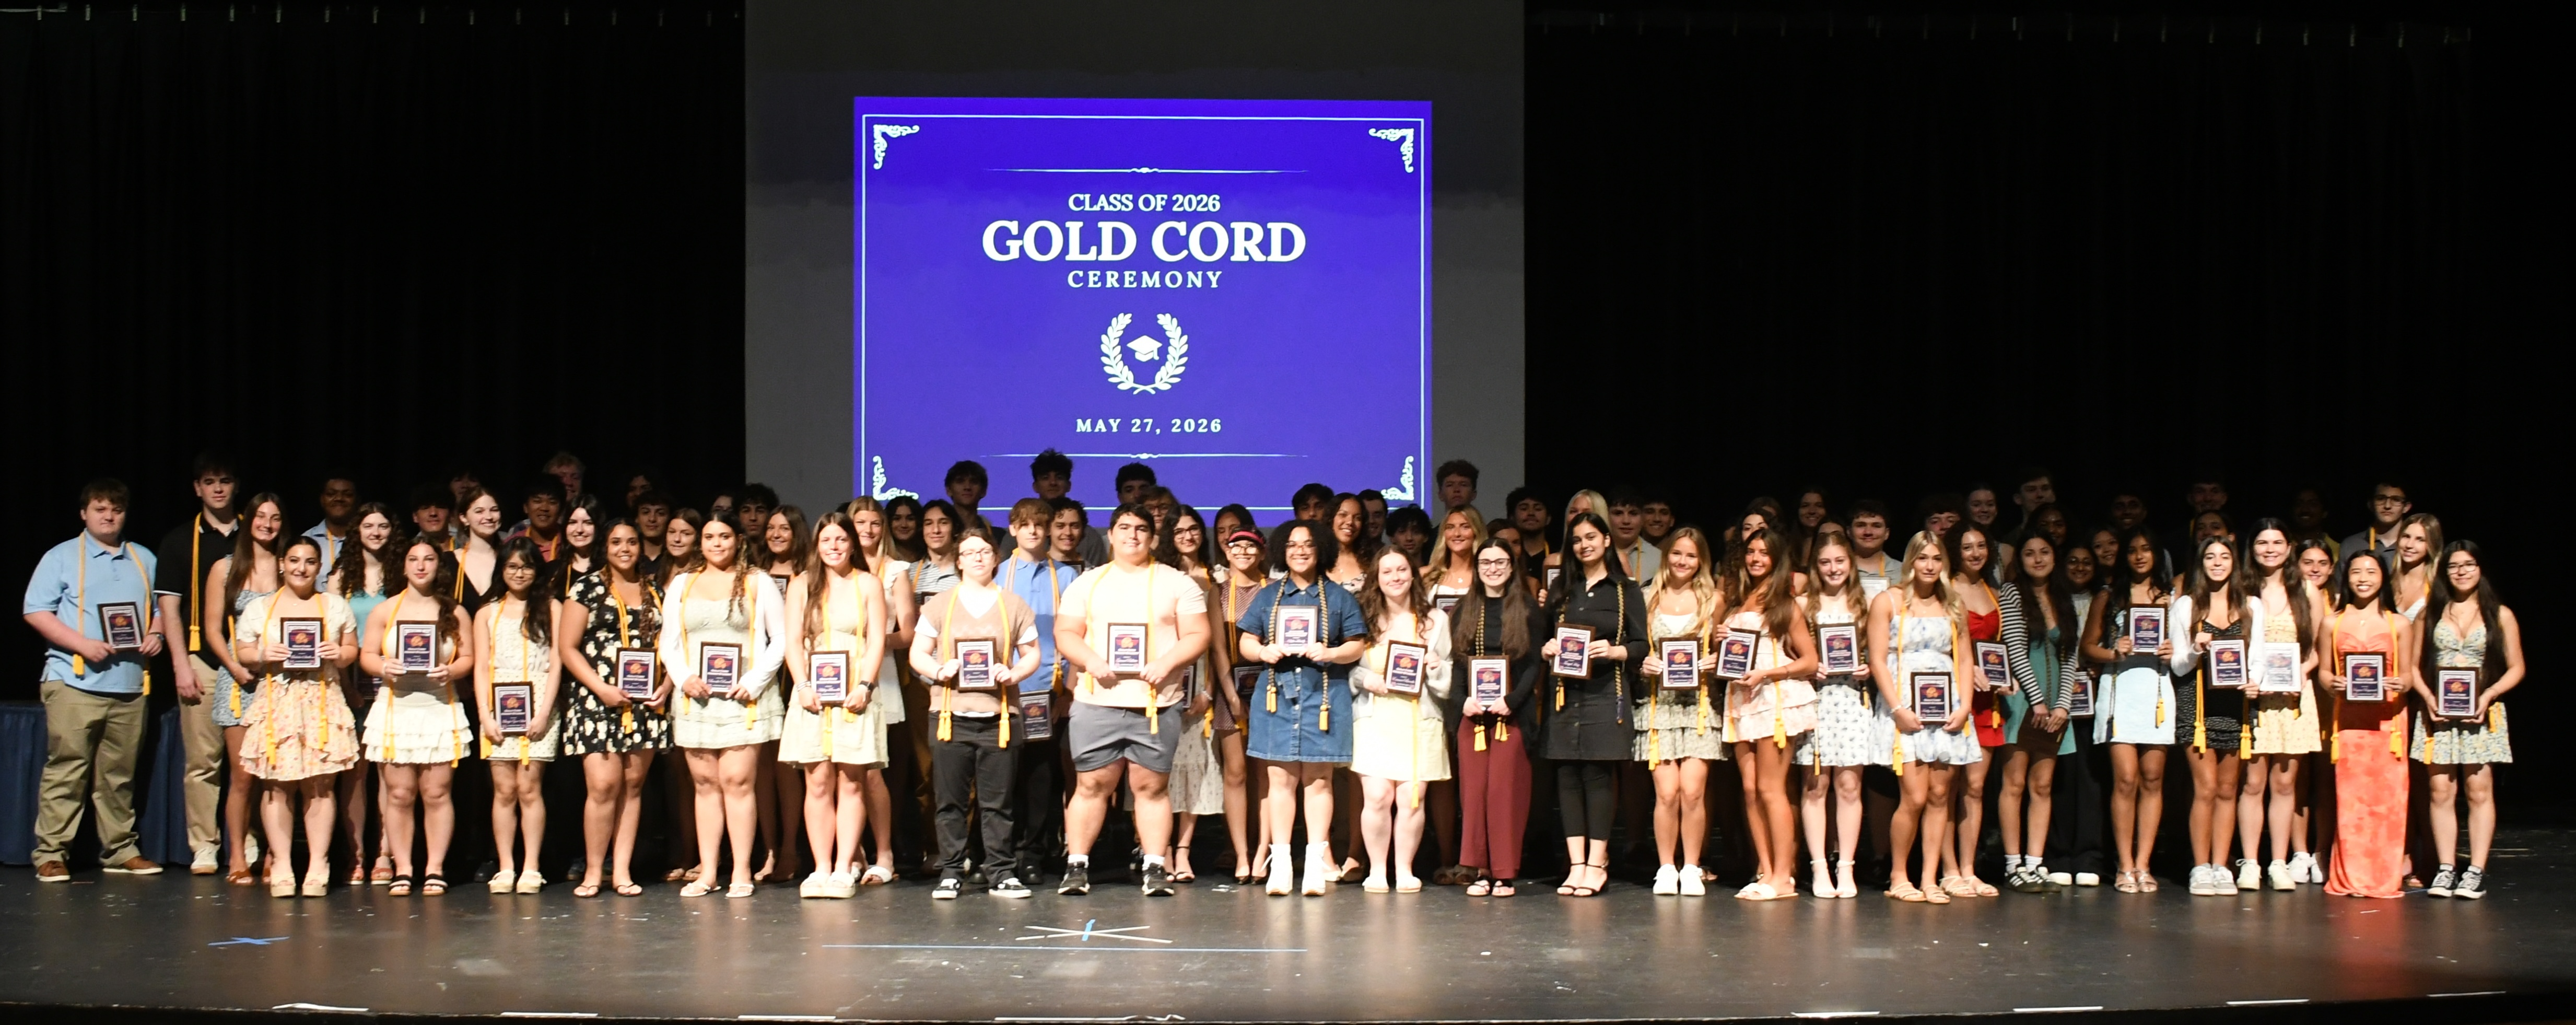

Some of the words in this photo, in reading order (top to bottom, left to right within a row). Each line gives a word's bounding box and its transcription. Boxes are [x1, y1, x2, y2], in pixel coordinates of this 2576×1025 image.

[1069, 194, 1133, 212] CLASS
[1139, 194, 1167, 212] OF
[1172, 194, 1220, 212] 2026
[982, 220, 1137, 262] GOLD
[1152, 221, 1306, 262] CORD
[1068, 271, 1222, 288] CEREMONY
[1076, 418, 1121, 433] MAY
[1131, 418, 1160, 435] 27,
[1171, 418, 1221, 433] 2026
